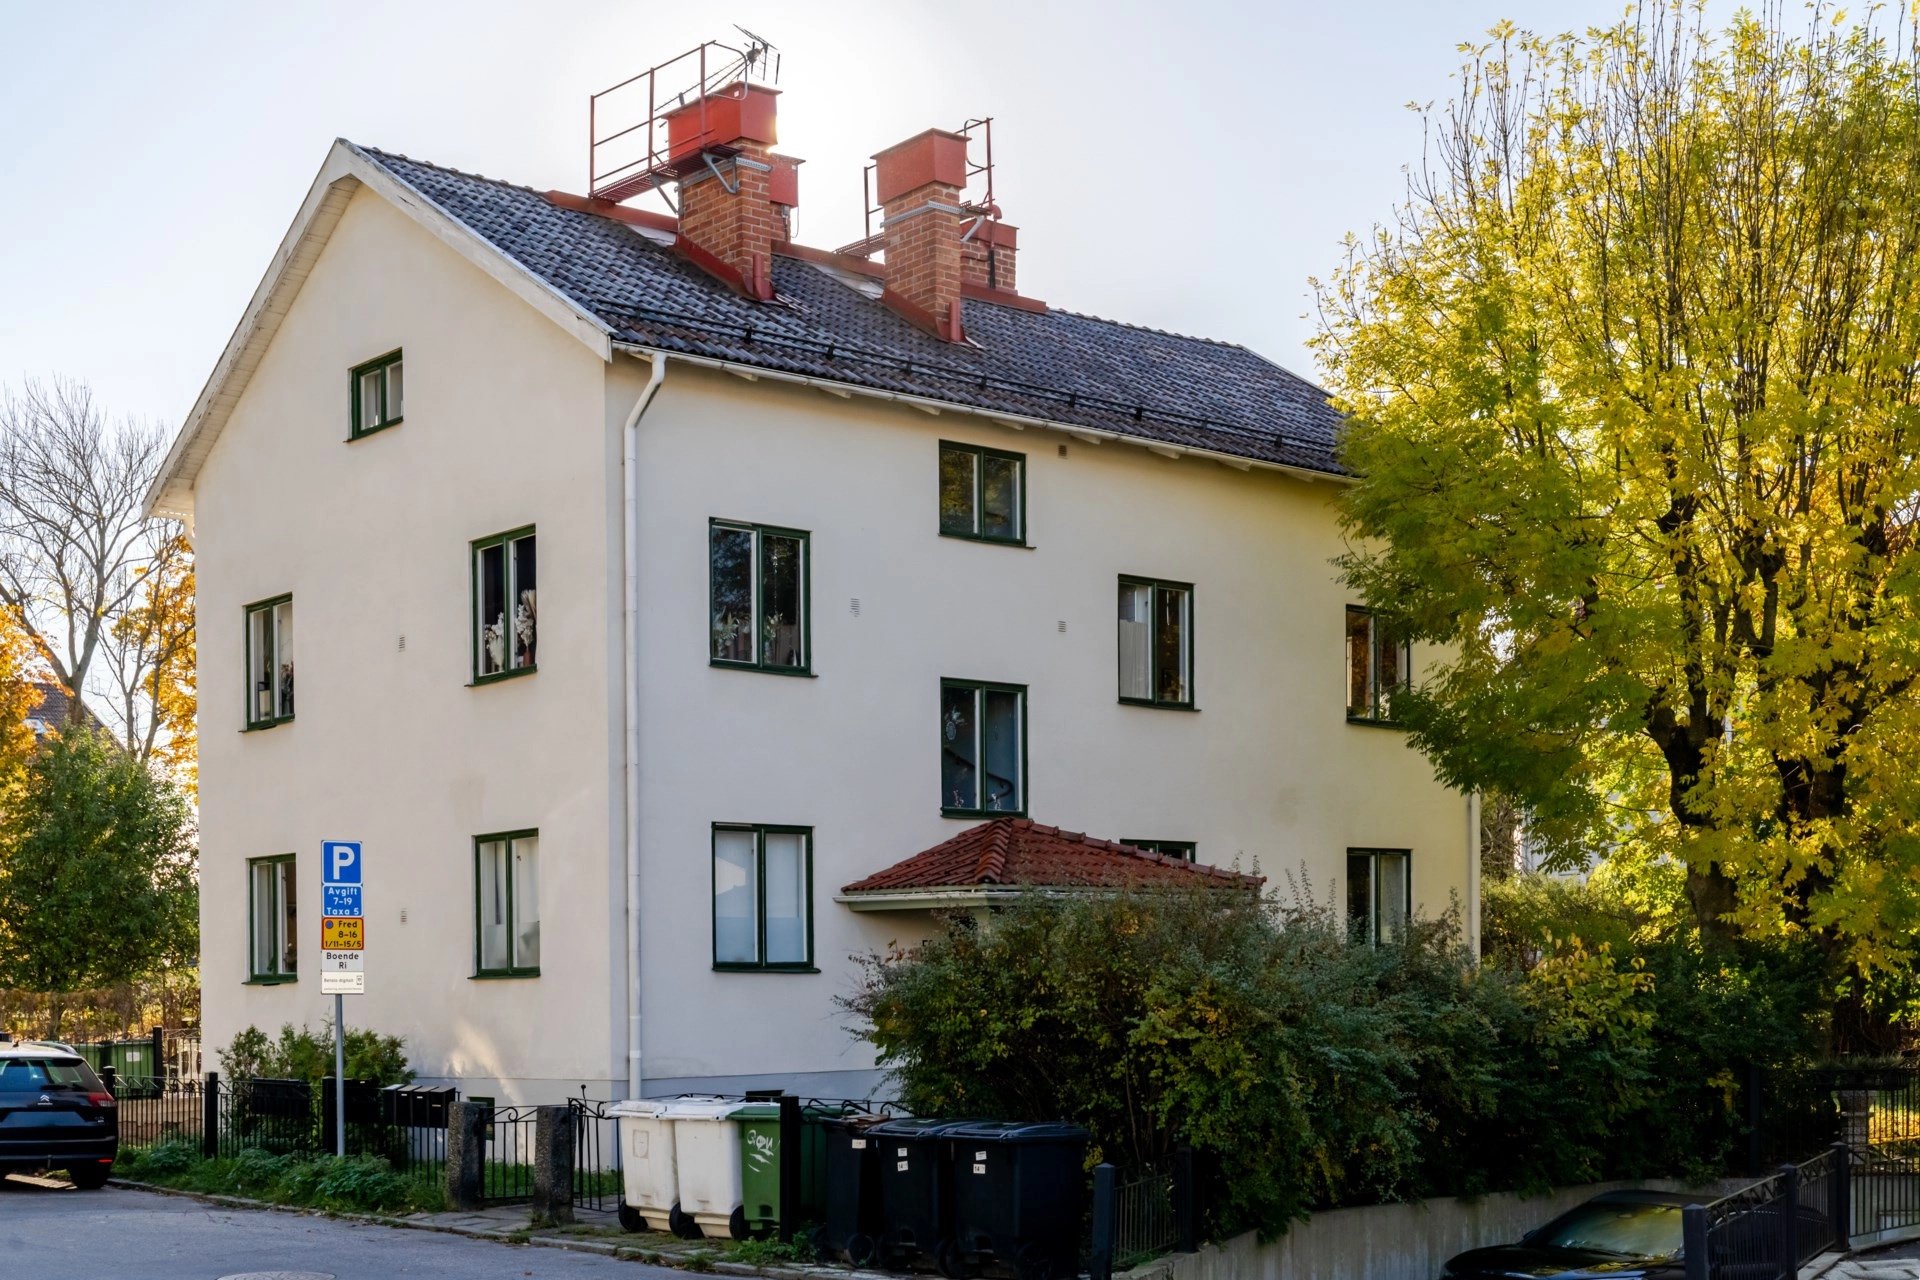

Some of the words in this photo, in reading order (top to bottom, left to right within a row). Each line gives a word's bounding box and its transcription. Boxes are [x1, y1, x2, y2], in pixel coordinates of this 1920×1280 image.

[333, 846, 355, 880] P
[328, 887, 358, 897] Avgift
[333, 897, 353, 905] 7-19
[326, 907, 350, 915] Taxa
[353, 907, 360, 915] 5
[338, 920, 358, 928] Fred
[338, 930, 358, 938] 8-16
[325, 940, 362, 948] 1/11-15/5
[326, 952, 359, 960] Boende
[338, 961, 347, 969] Ri
